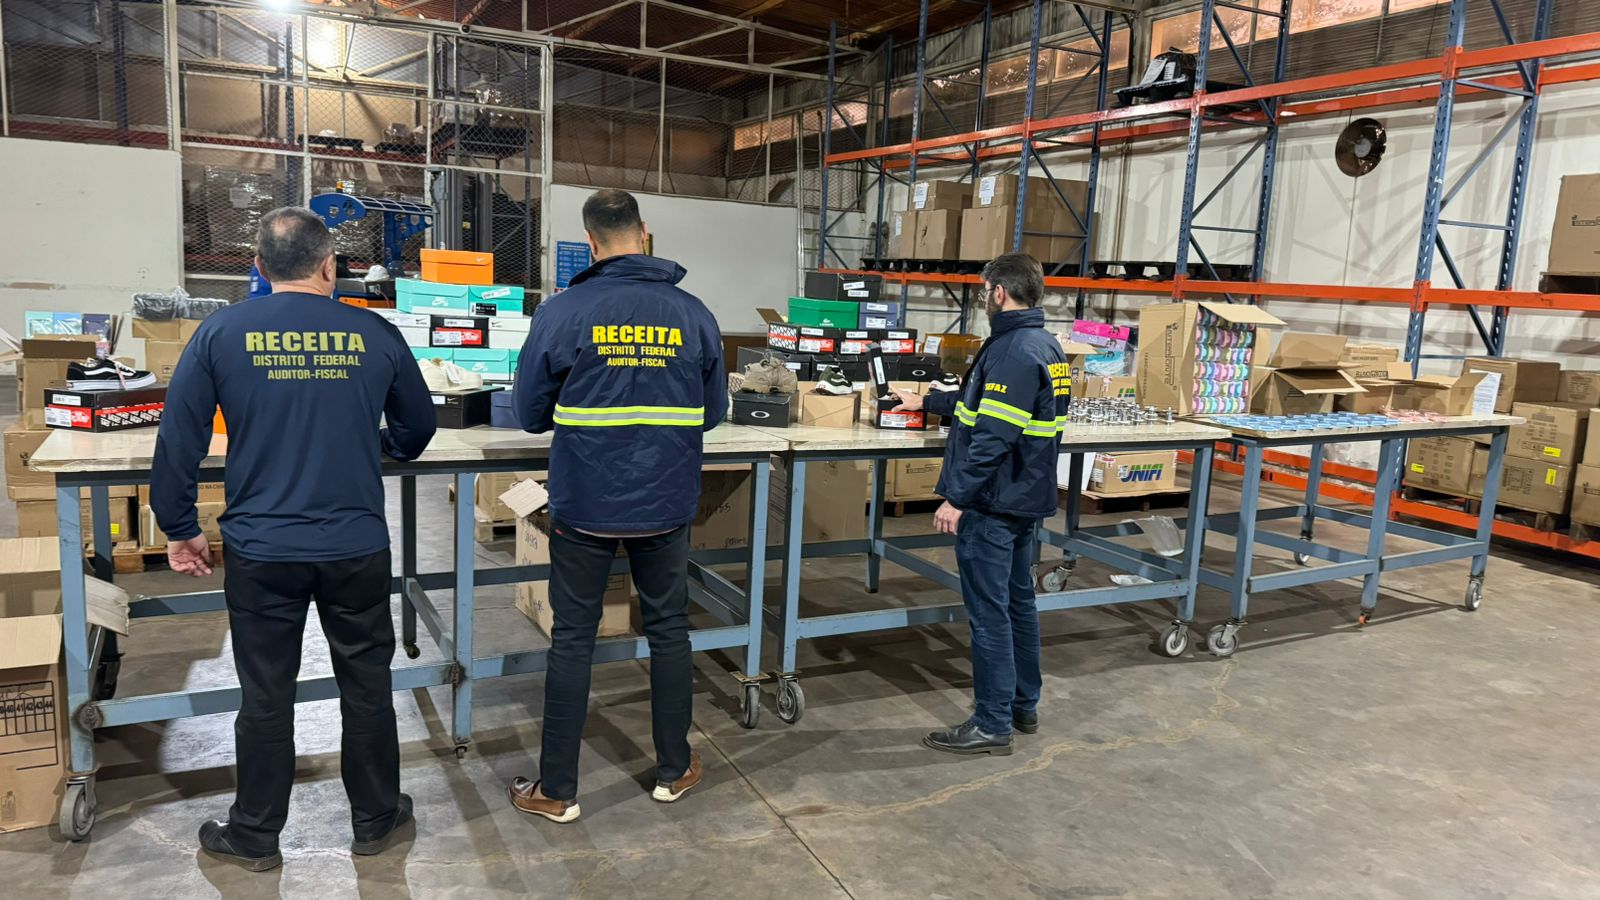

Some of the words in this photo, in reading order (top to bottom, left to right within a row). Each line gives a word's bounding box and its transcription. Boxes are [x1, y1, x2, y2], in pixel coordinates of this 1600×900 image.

[245, 331, 366, 352] RECEITA
[592, 325, 683, 346] RECEITA
[597, 345, 636, 356] DISTRITO
[640, 346, 677, 357] FEDERAL
[253, 354, 305, 367] DISTRITO
[313, 354, 361, 366] FEDERAL
[606, 357, 668, 368] AUDITOR-FISCAL
[267, 368, 349, 380] AUDITOR-FISCAL
